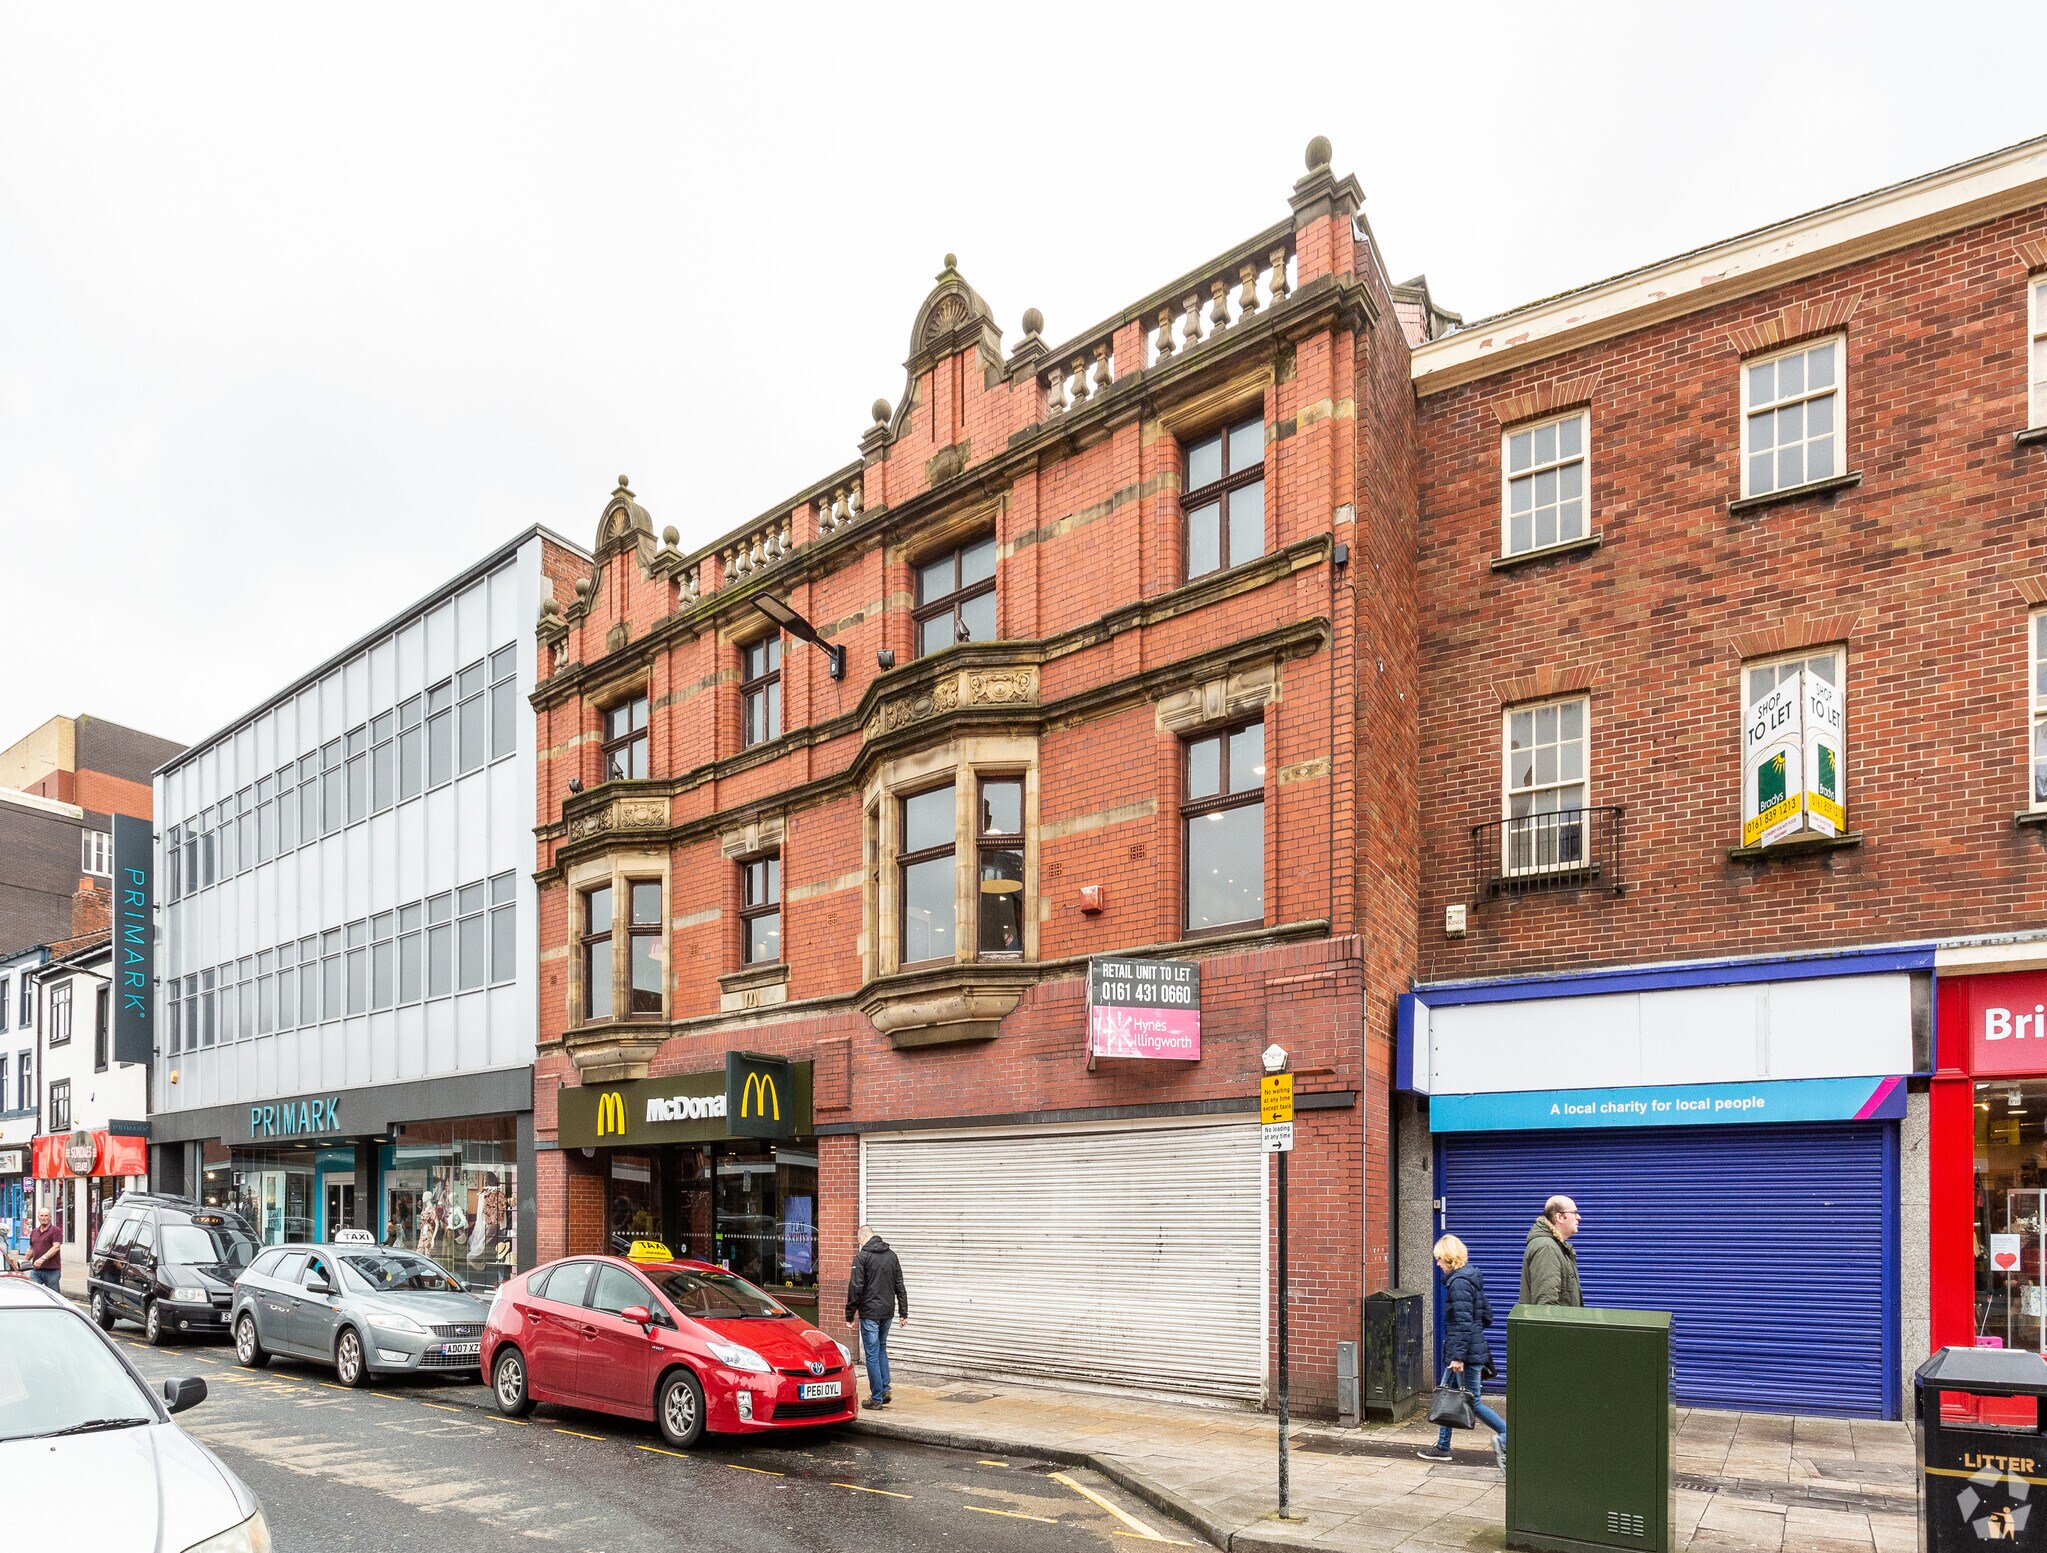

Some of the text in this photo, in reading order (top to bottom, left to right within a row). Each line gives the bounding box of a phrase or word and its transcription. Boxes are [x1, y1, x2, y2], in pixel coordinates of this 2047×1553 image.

[1816, 683, 1832, 702] SHOP
[1758, 692, 1781, 719] SHOP
[1811, 696, 1840, 729] TO LET
[1748, 701, 1792, 746] TO LET
[1819, 783, 1834, 800] Bradys
[1760, 792, 1784, 812] Bradys
[1747, 817, 1763, 833] 0161
[1764, 809, 1777, 824] 839
[1779, 798, 1796, 815] 1213
[124, 867, 145, 1010] PRIMARK
[1102, 963, 1191, 982] RETAIL UNIT TO LET
[1102, 981, 1191, 1004] 0161 431 0660
[1133, 1018, 1167, 1035] Hynes
[1985, 1004, 2045, 1041] Bri
[1134, 1033, 1192, 1051] Illingworth
[1550, 1096, 1765, 1115] A local charity for local people
[251, 1097, 340, 1138] PRIMARK
[112, 1124, 149, 1132] PRIMARK
[790, 1221, 806, 1232] FLAT
[343, 1233, 370, 1241] TAXI
[638, 1241, 666, 1250] TAXI
[224, 1313, 231, 1321] S
[469, 1343, 481, 1353] XZ
[806, 1383, 839, 1397] PE61 OYL
[1964, 1453, 2035, 1472] LITTER
